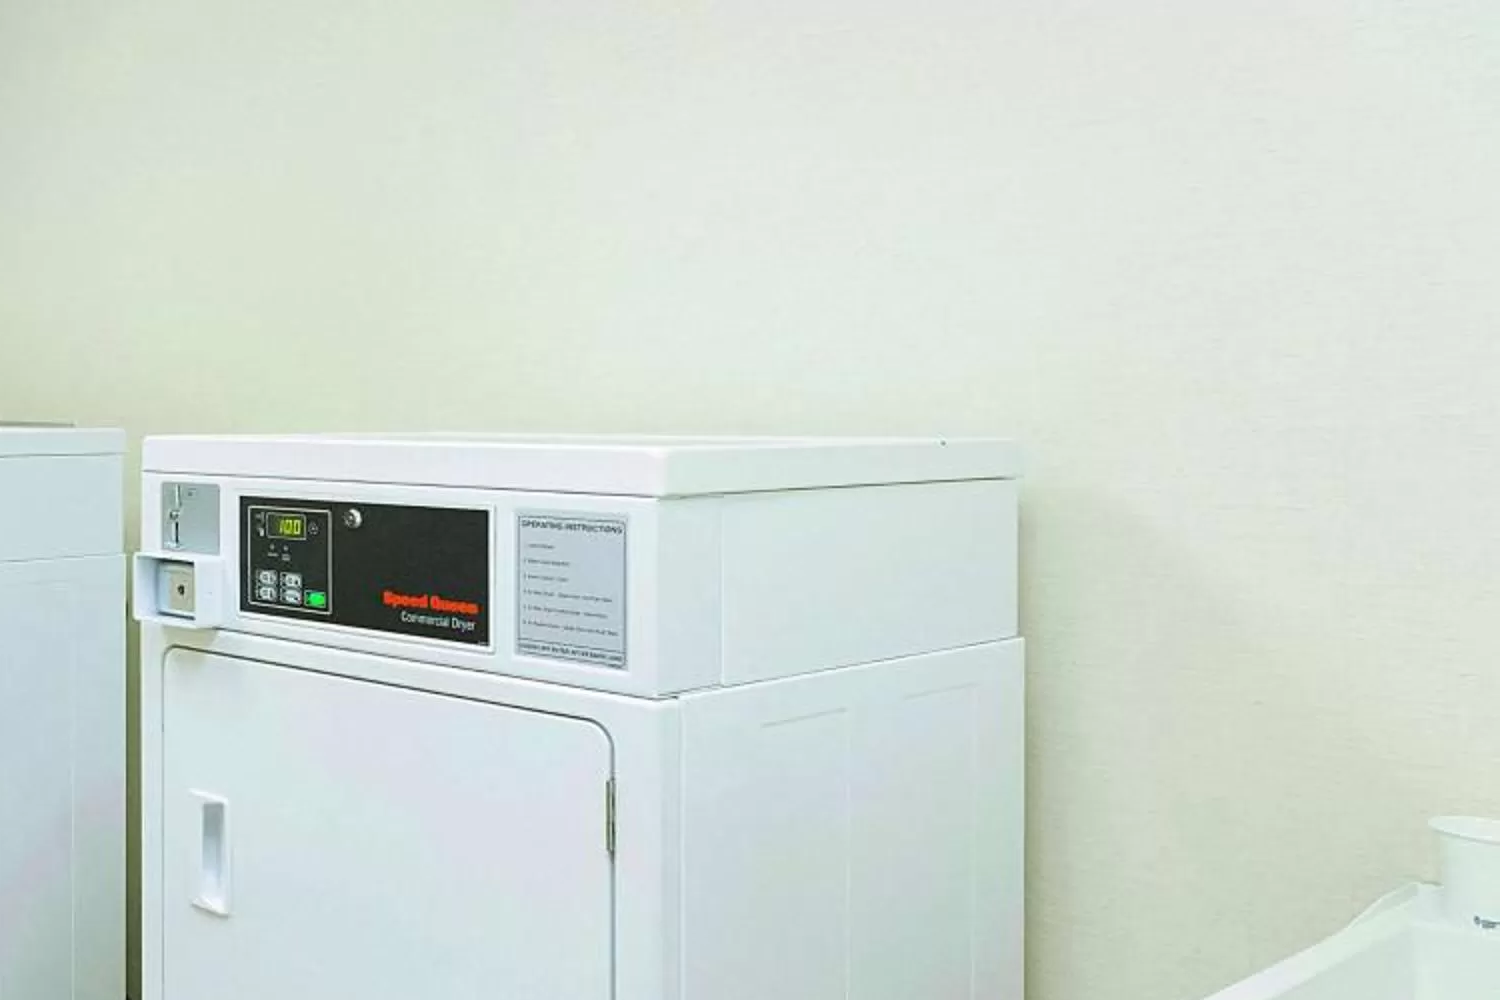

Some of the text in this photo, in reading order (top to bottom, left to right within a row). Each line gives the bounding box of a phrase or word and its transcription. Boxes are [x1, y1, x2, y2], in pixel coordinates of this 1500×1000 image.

[521, 520, 622, 535] OPERATING INSTRUCTIONS
[383, 591, 479, 614] Speed Queen
[401, 610, 477, 632] Commercial Dryer
